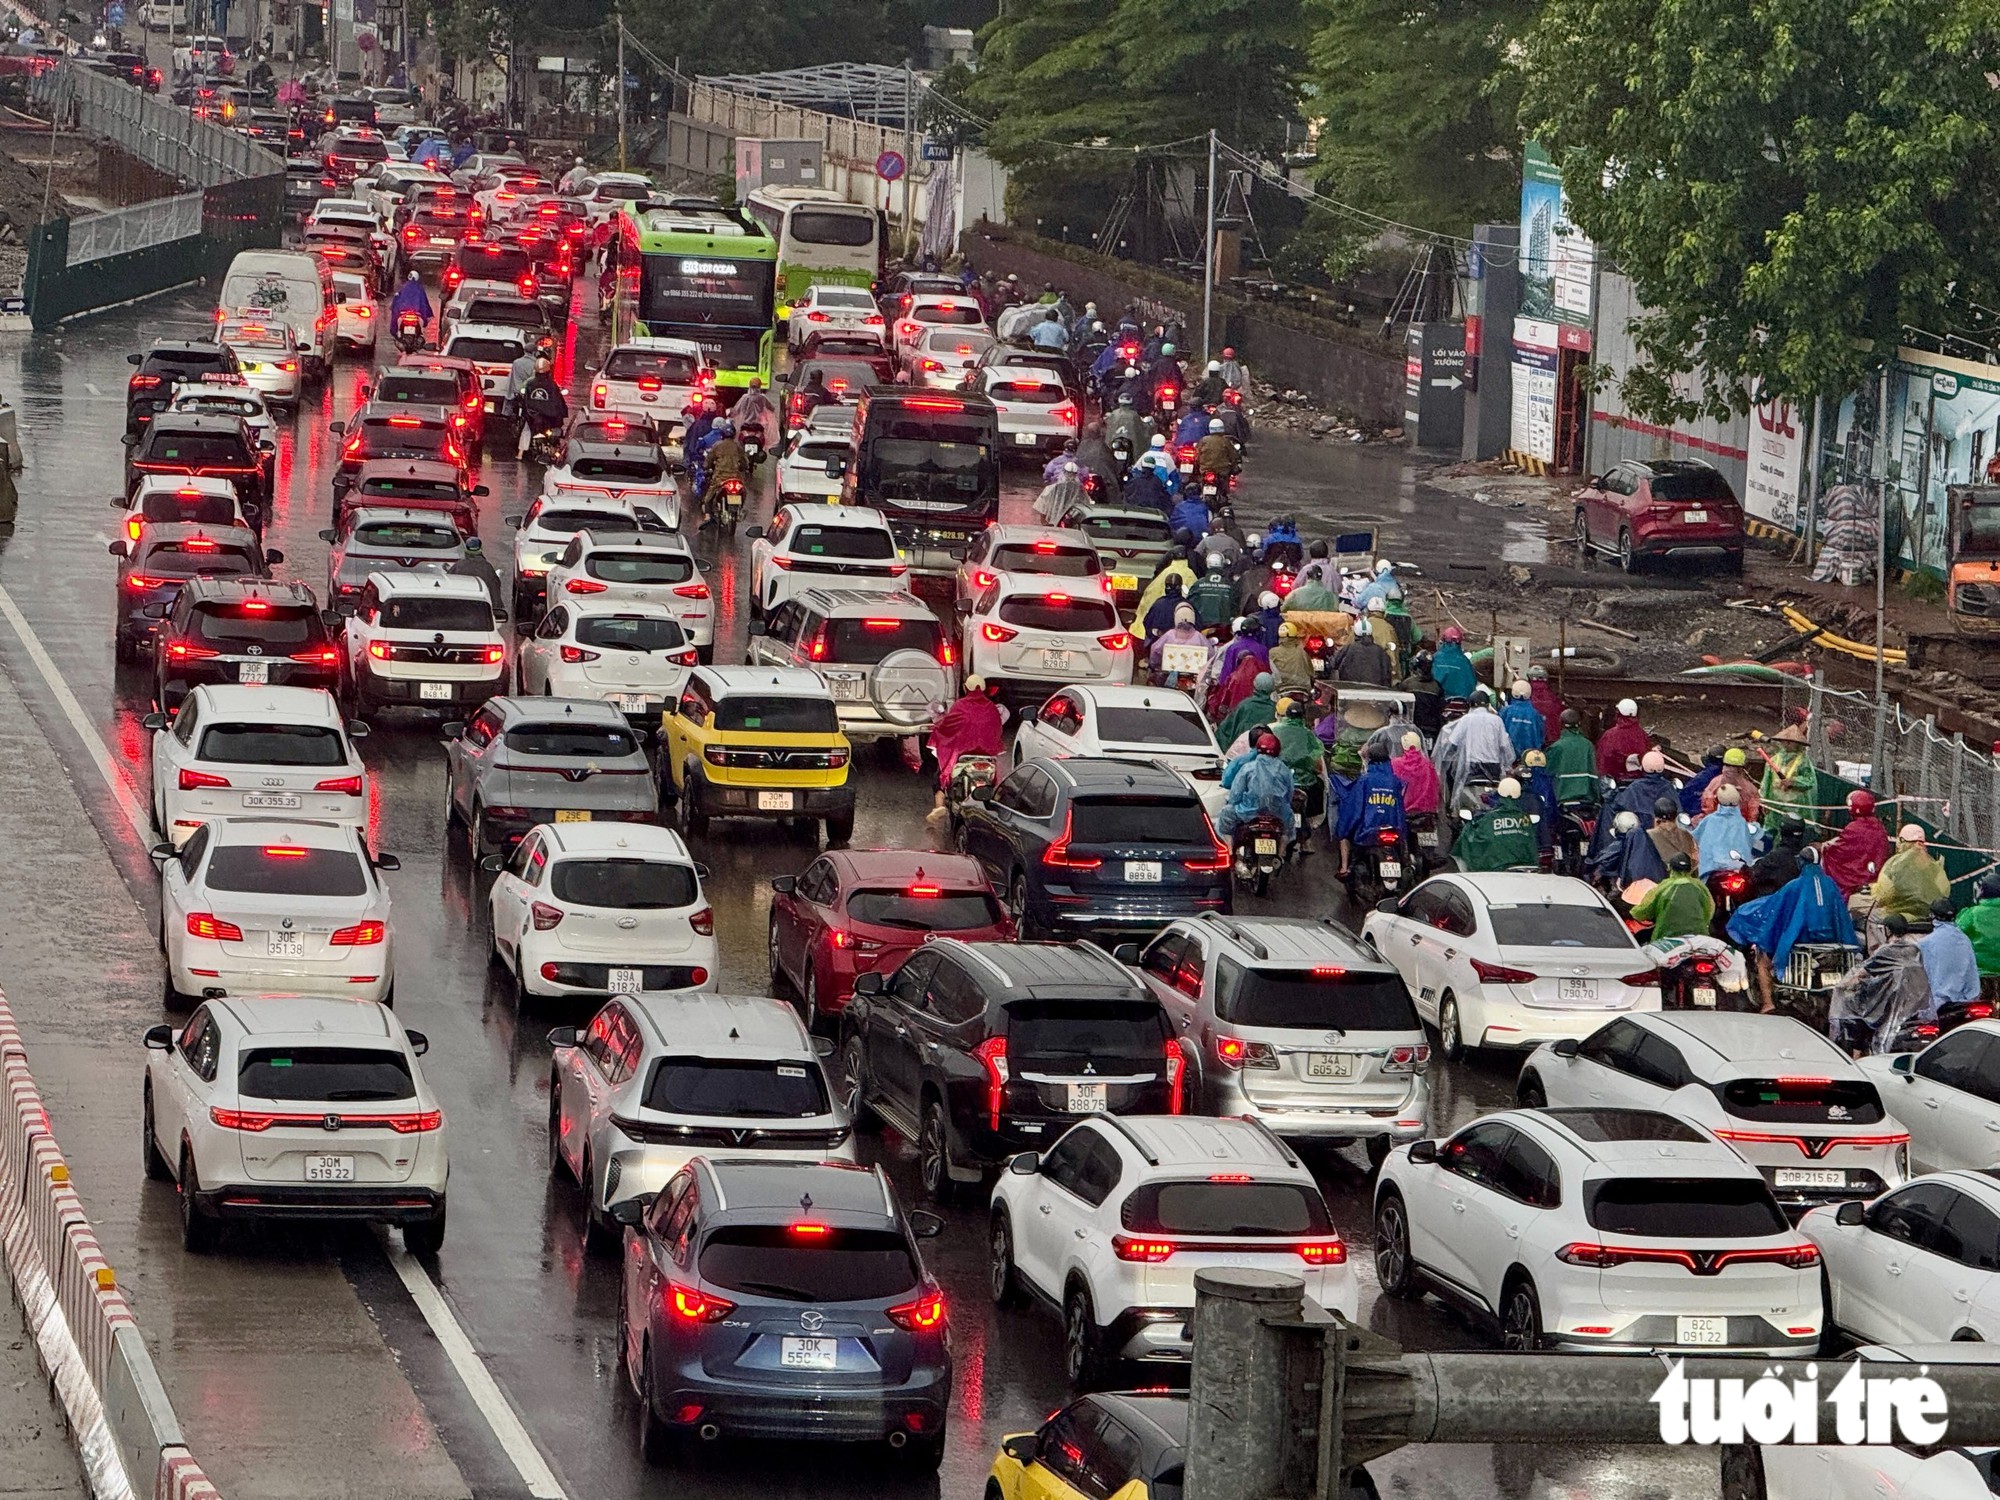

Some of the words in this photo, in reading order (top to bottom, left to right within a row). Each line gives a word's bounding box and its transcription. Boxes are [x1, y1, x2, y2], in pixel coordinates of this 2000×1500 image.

[928, 147, 949, 157] ATM
[1432, 347, 1447, 357] LỐI
[1447, 347, 1466, 357] VÀO
[1433, 356, 1465, 366] XƯỞNG
[221, 373, 239, 381] 123
[1049, 651, 1064, 660] 30E
[246, 663, 261, 673] 30F
[429, 683, 442, 691] 99A
[835, 681, 852, 690] 30U
[626, 694, 639, 703] 30F
[248, 796, 297, 806] 30K-355.35
[1493, 817, 1522, 830] BIDV
[1135, 863, 1151, 871] 30L
[1129, 872, 1157, 880] 889.84
[277, 932, 296, 942] 30E
[269, 943, 303, 954] 351.38
[616, 971, 635, 982] 99A
[1570, 979, 1587, 989] 99A
[1563, 989, 1594, 998] 790.70
[1321, 1055, 1340, 1065] 34A
[1313, 1065, 1347, 1075] 605.29
[1077, 1086, 1096, 1098] 30F
[1070, 1099, 1105, 1111] 388.75
[319, 1157, 341, 1168] 30M
[310, 1169, 350, 1179] 519.22
[1782, 1172, 1840, 1183] 30B-215.62
[1691, 1320, 1712, 1330] 82C
[1683, 1331, 1721, 1342] 091.22
[798, 1339, 821, 1351] 30K
